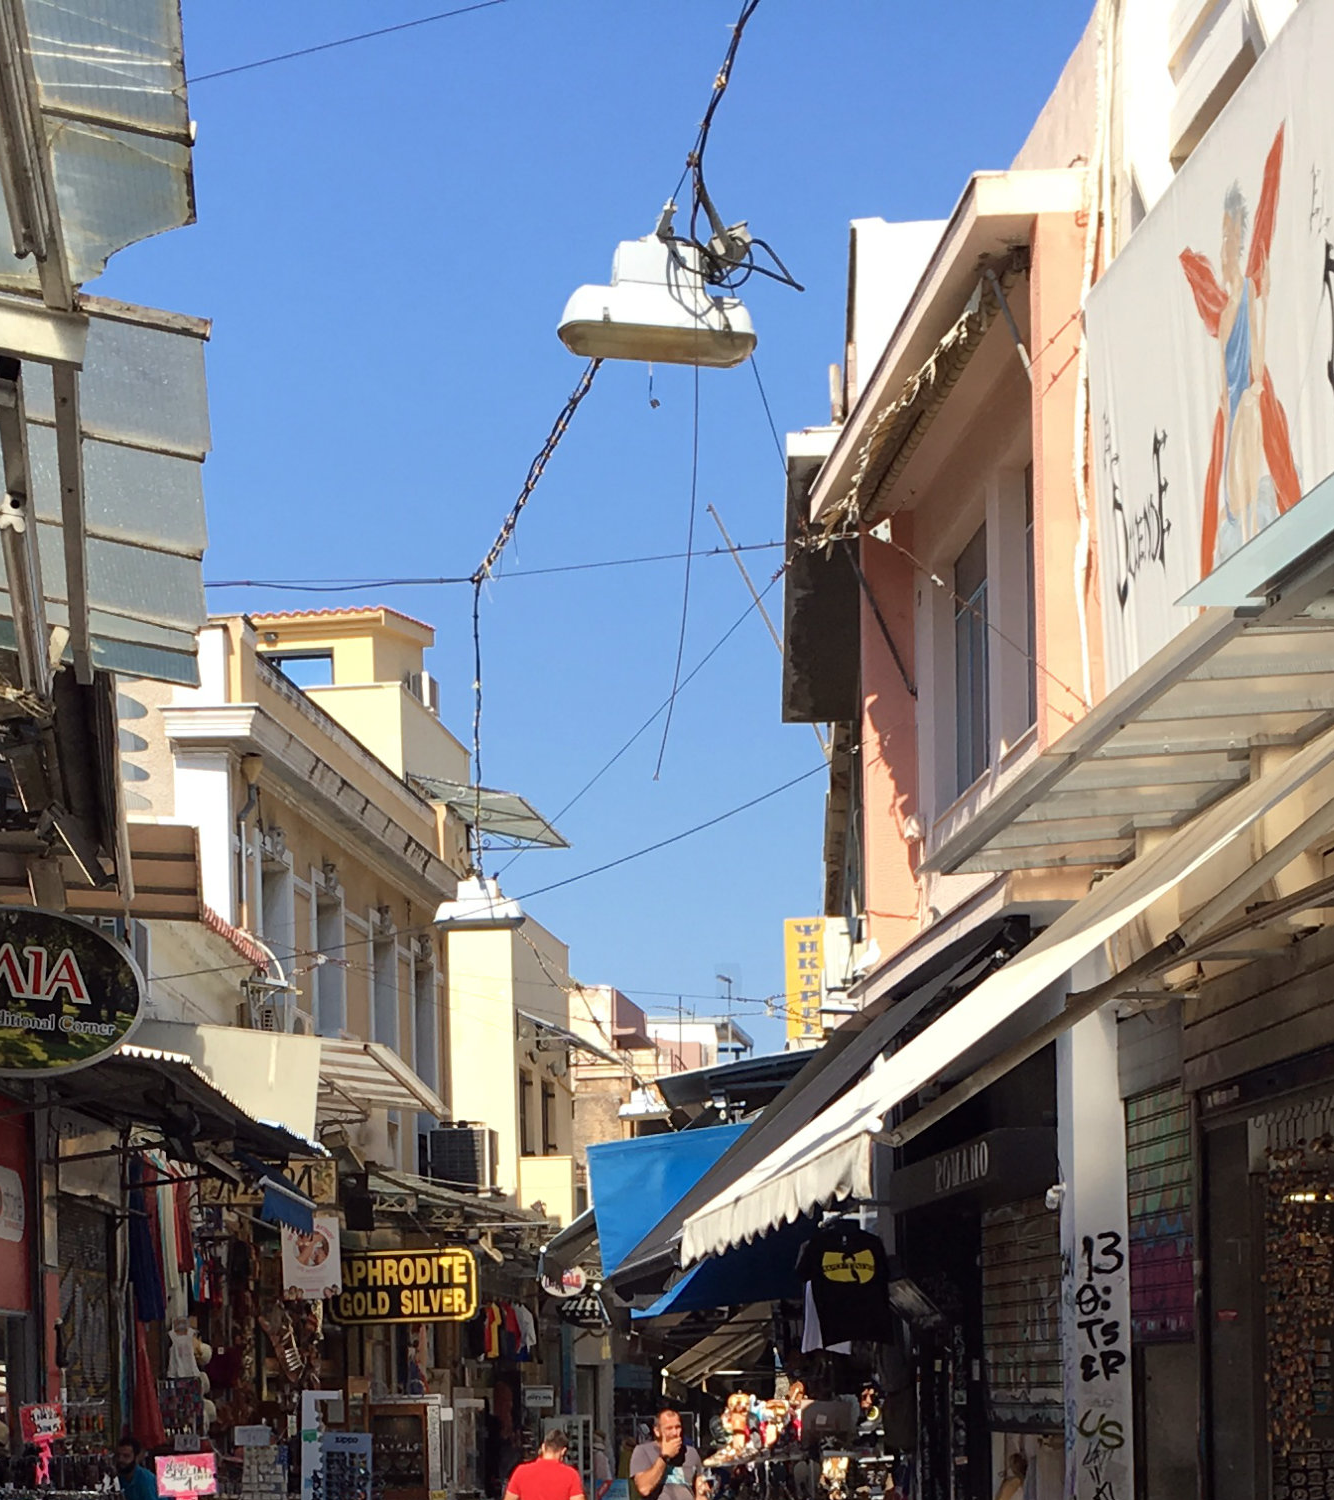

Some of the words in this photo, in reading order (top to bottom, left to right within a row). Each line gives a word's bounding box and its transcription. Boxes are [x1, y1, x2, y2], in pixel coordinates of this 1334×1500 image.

[58, 1016, 115, 1037] Corner
[935, 1140, 989, 1193] ROMANO
[342, 1256, 468, 1286] APHRODITE
[1082, 1231, 1124, 1282] 13
[340, 1290, 390, 1317] GOLD
[400, 1287, 467, 1316] SILVER
